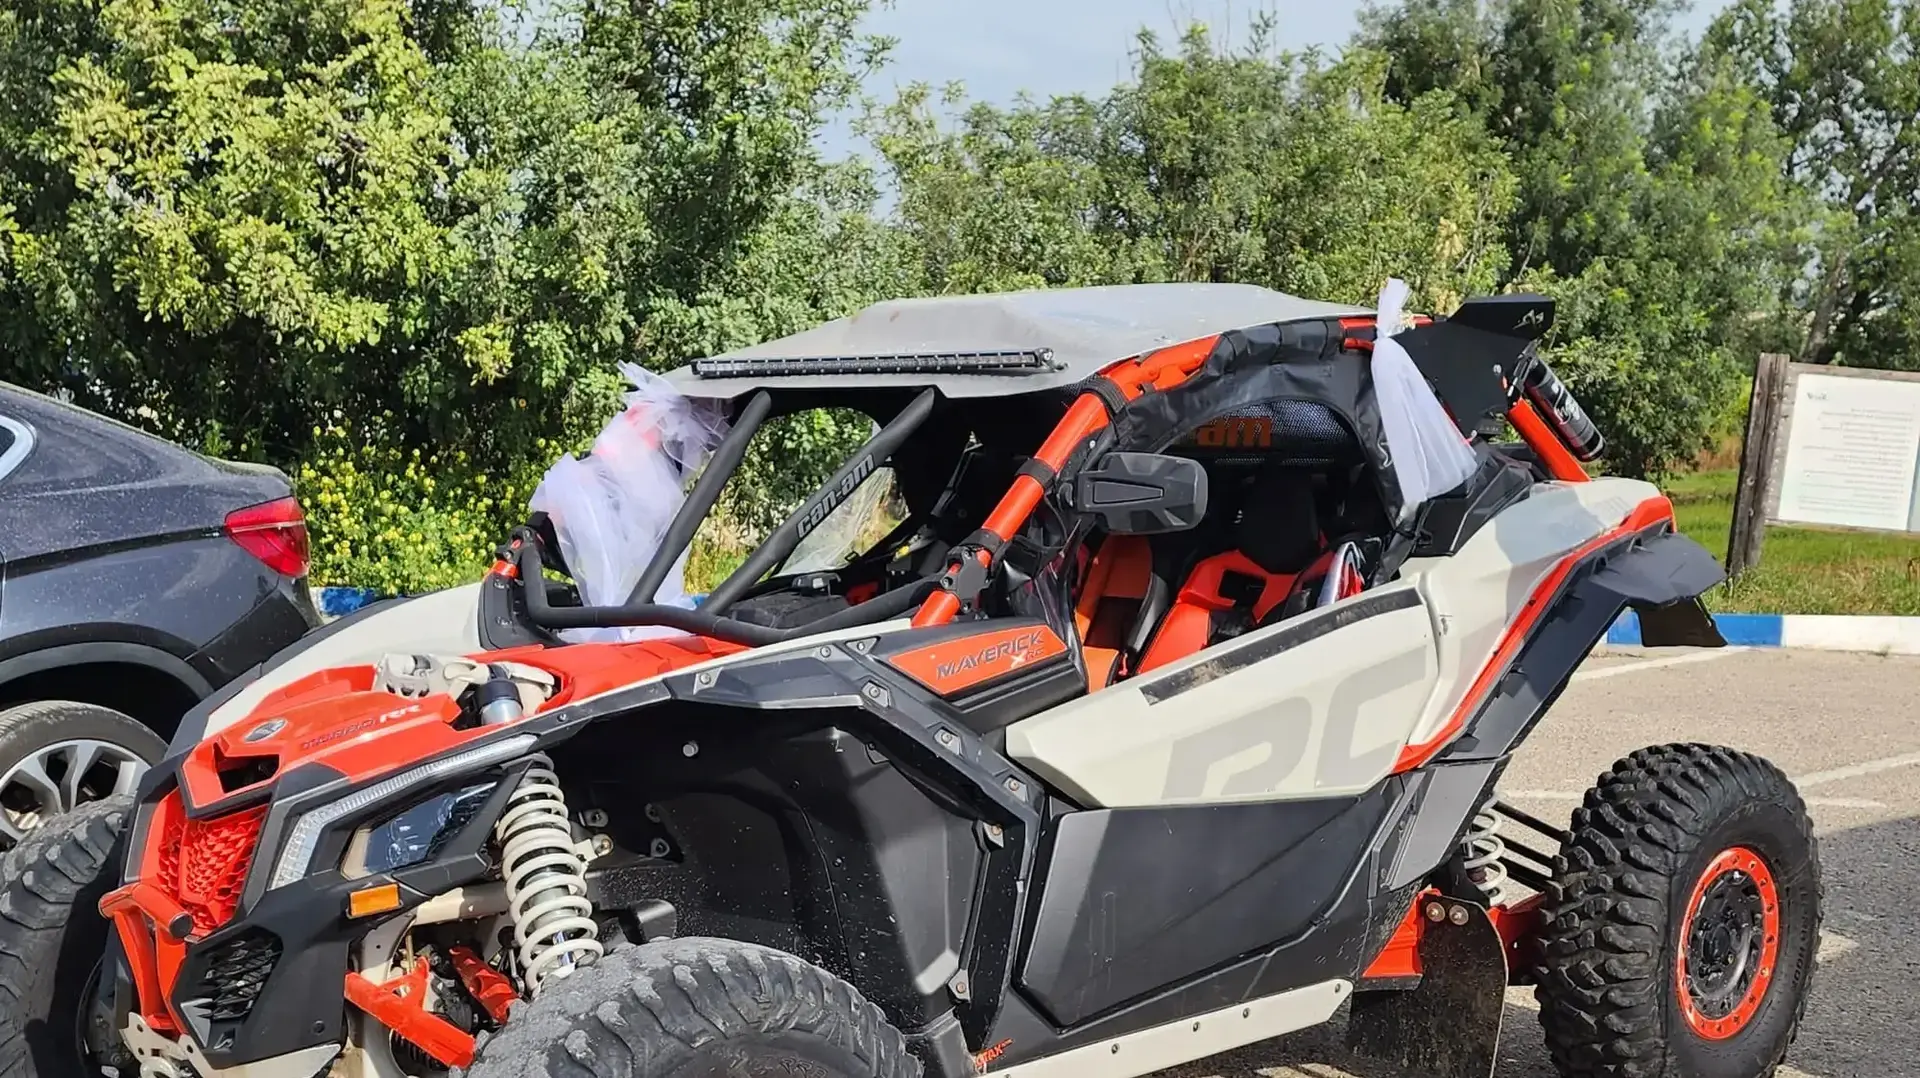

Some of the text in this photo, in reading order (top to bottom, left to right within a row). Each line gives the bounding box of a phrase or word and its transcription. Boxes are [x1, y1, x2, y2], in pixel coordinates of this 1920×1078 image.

[797, 453, 874, 539] can-am
[936, 630, 1043, 680] MAVERICK
[379, 704, 421, 724] RR
